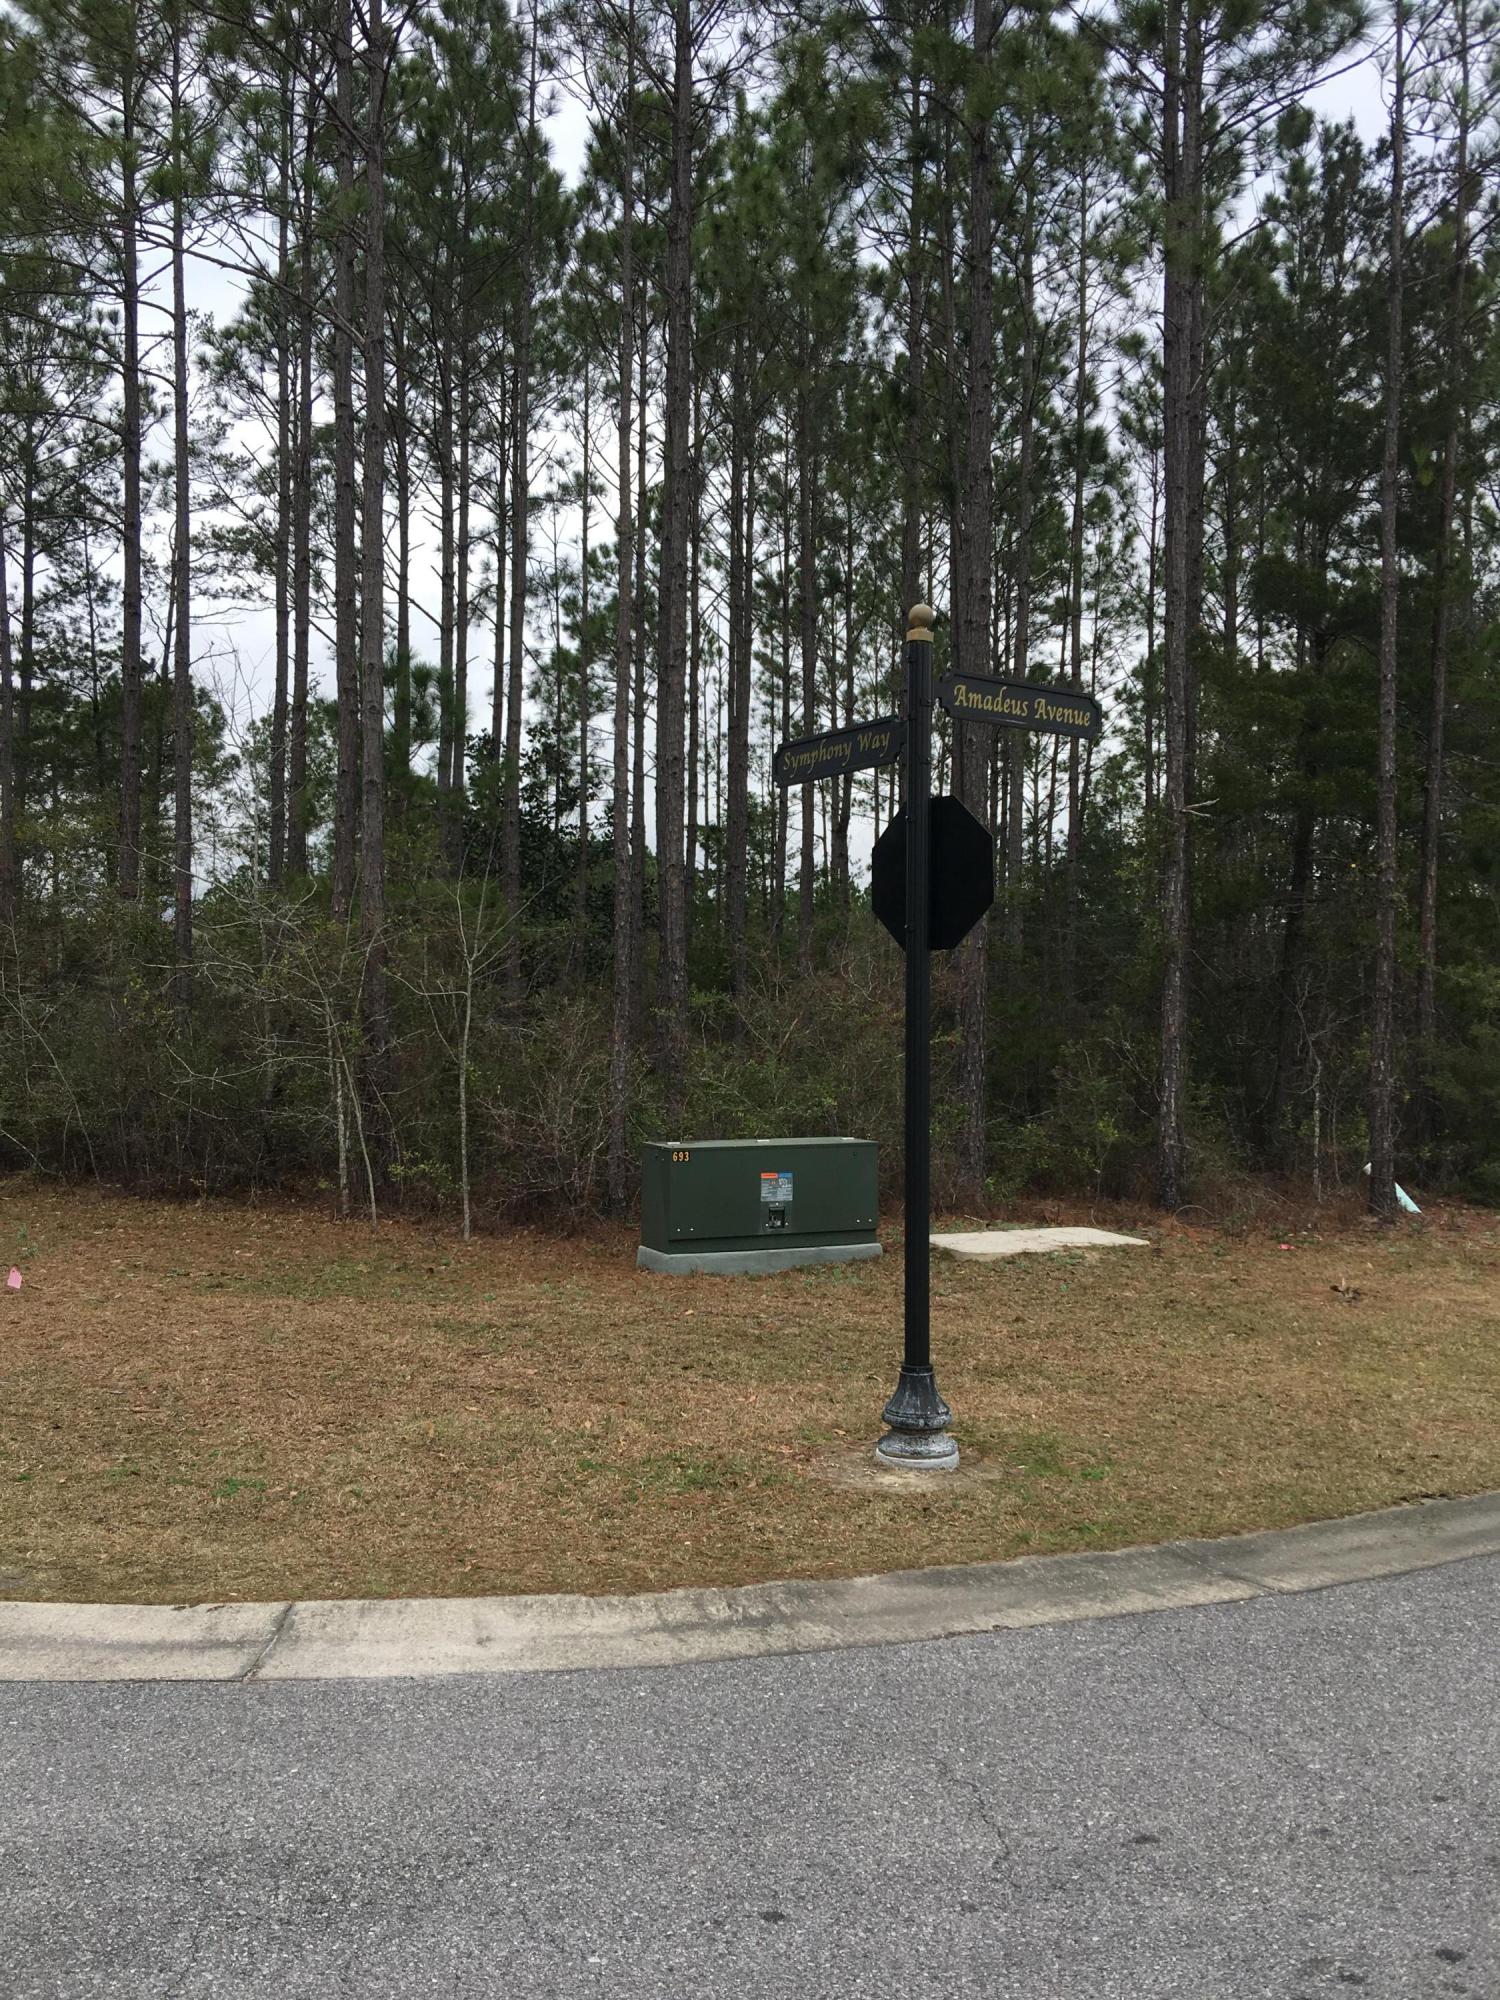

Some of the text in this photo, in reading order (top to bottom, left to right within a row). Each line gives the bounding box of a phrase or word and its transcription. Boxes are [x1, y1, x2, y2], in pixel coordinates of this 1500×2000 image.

[953, 684, 1091, 727] Amadeus Avenue
[782, 731, 890, 776] Symphony Way
[672, 1151, 690, 1162] 693
